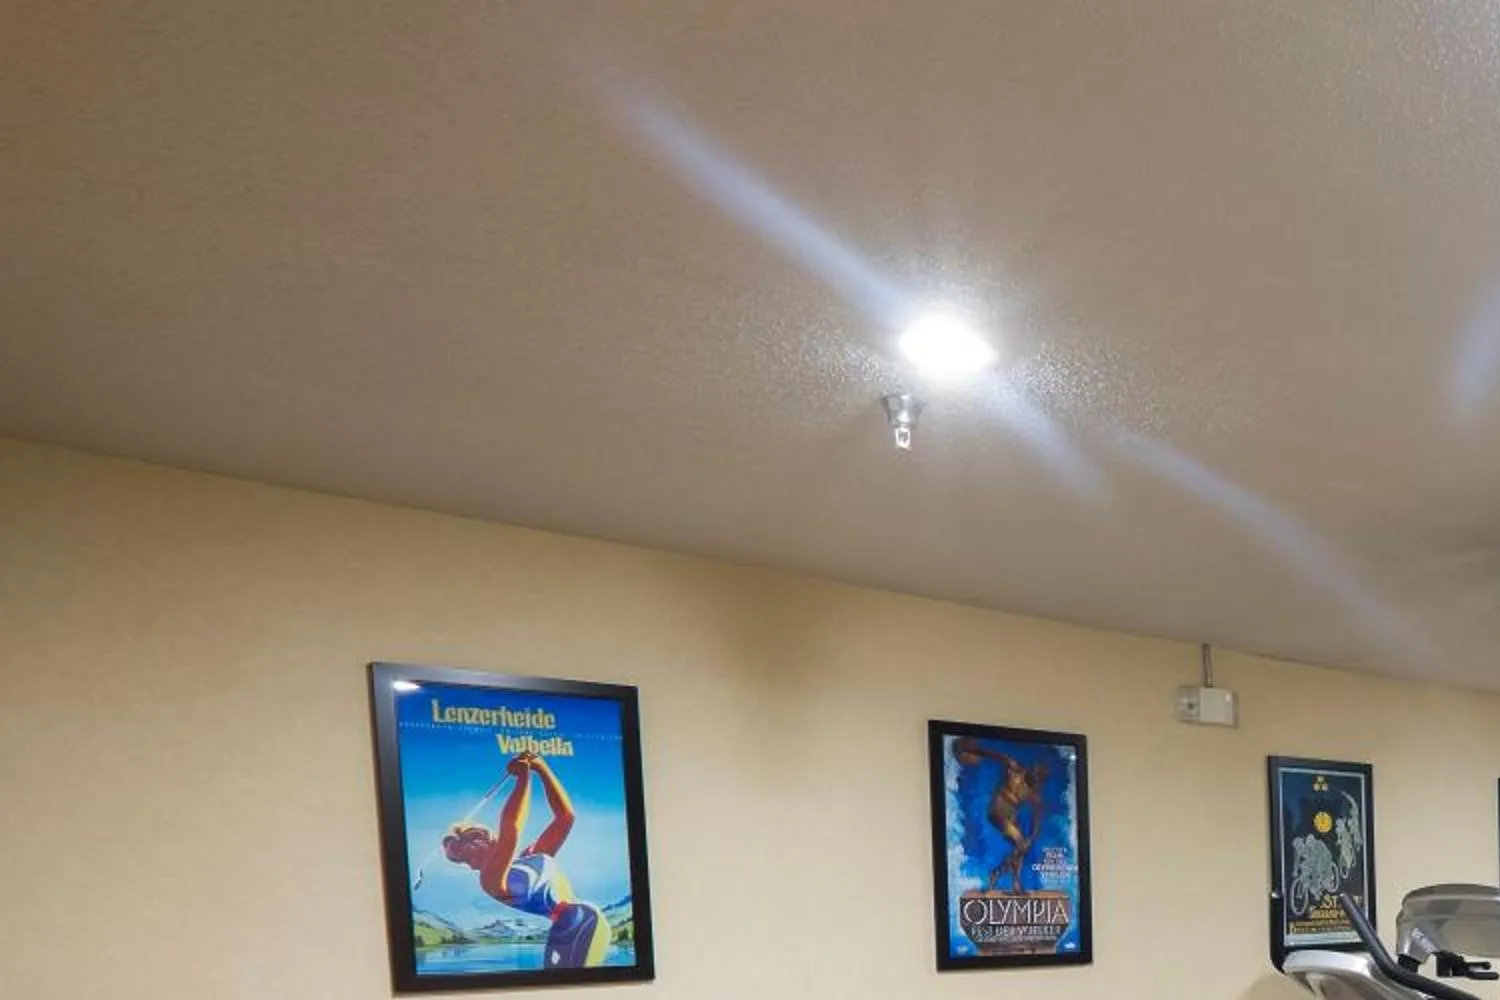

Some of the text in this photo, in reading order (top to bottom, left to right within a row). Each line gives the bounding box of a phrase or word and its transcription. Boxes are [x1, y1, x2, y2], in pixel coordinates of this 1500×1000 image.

[431, 699, 556, 729] Lenzerheide
[496, 734, 574, 756] Valbella
[963, 899, 1070, 925] OLYMPIA
